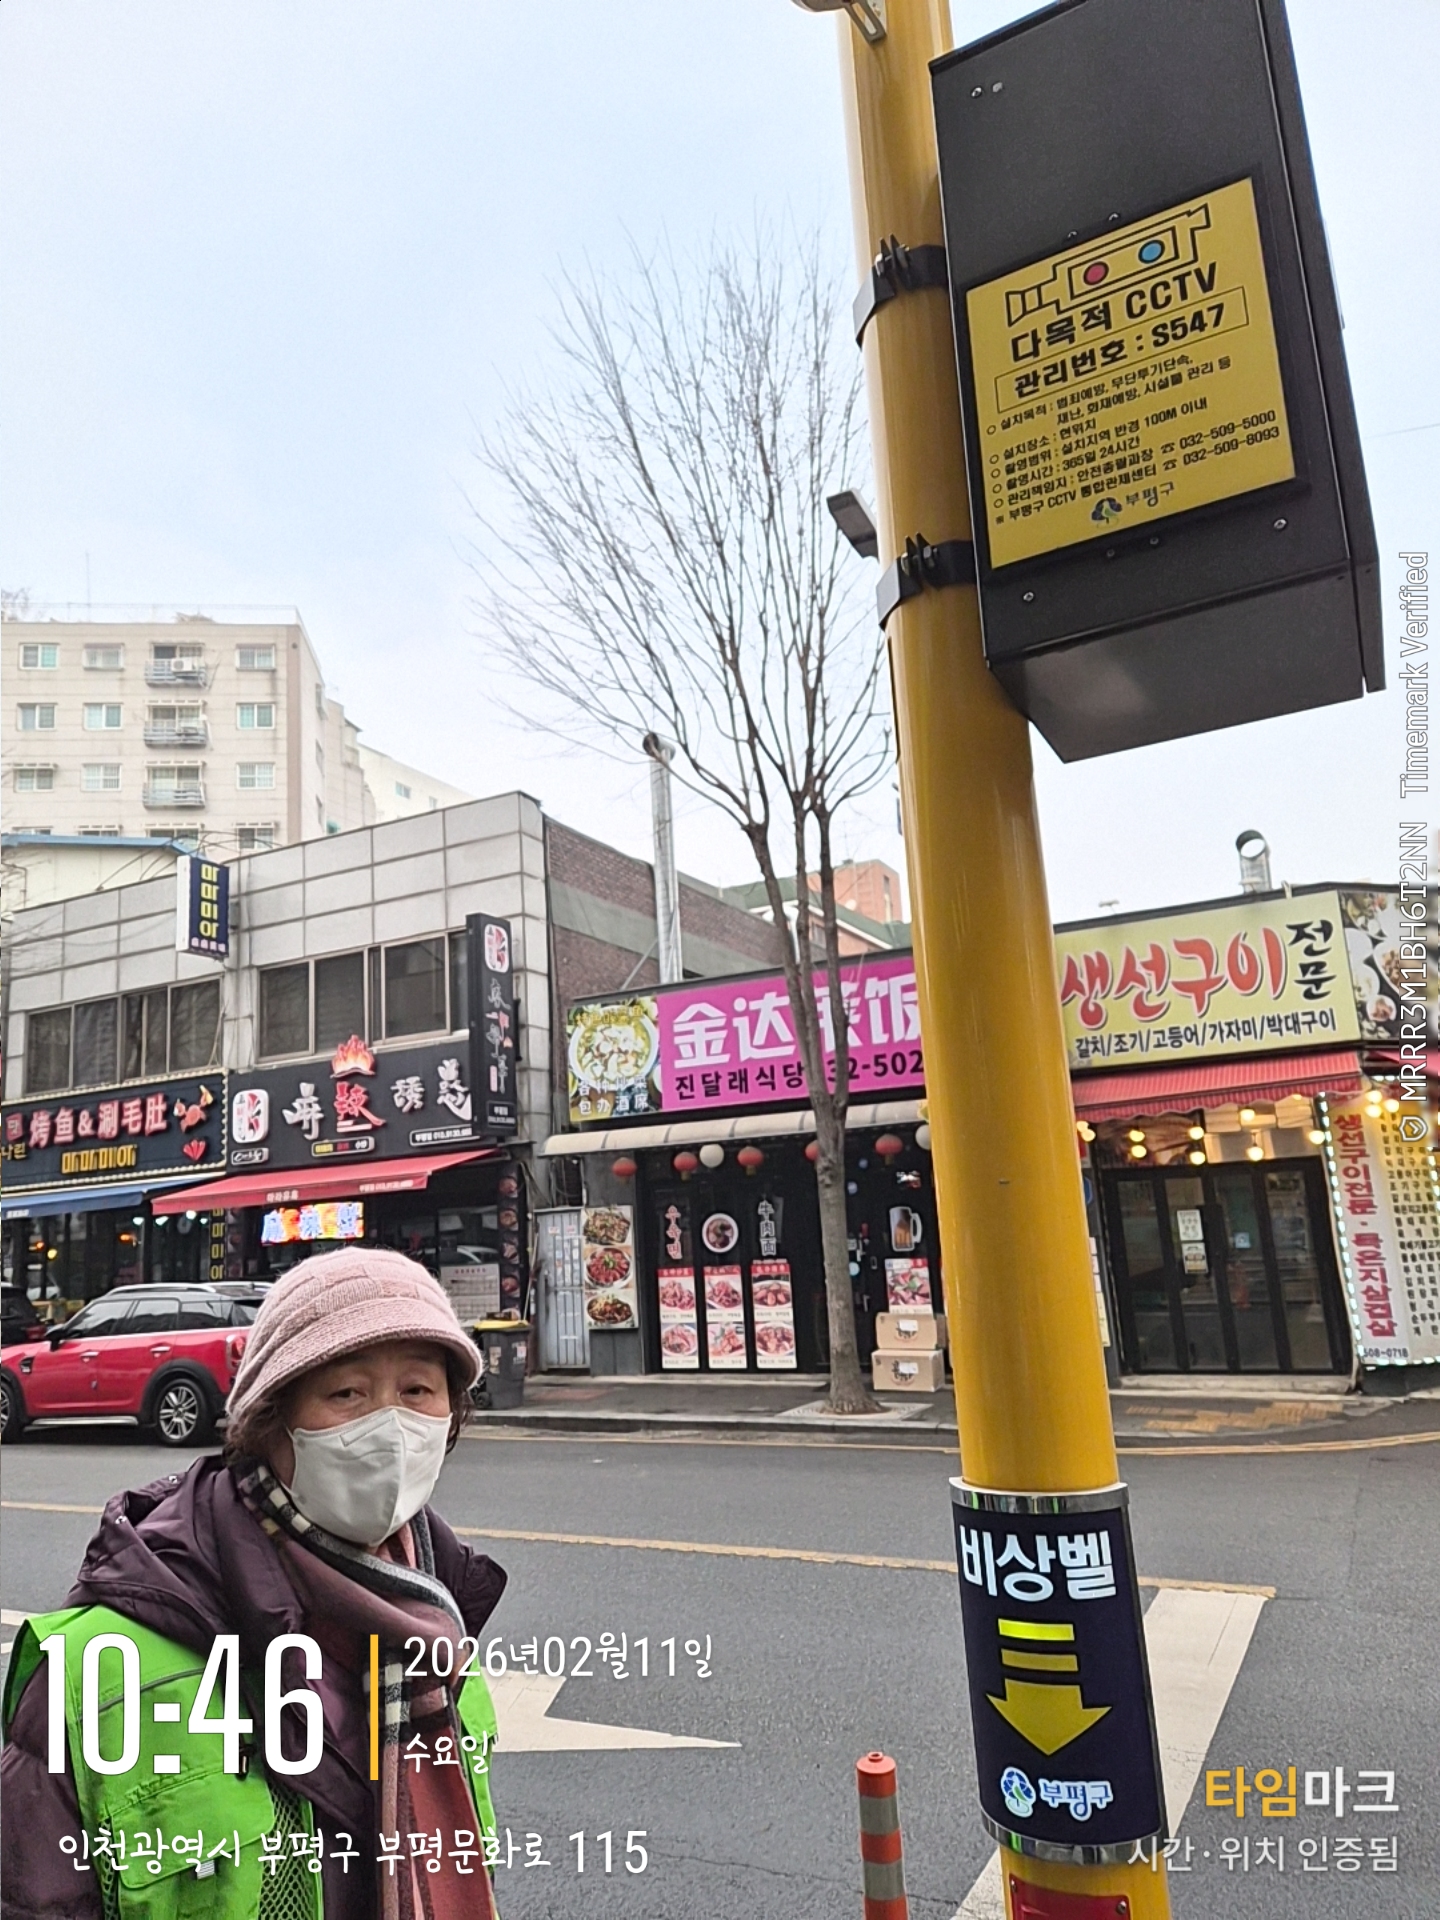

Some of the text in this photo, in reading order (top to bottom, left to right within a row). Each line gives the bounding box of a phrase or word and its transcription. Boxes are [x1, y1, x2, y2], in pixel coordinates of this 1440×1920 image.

[1011, 262, 1217, 362] 다목적 CCTV
[1014, 339, 1128, 398] 관리번호
[1151, 303, 1225, 348] S547
[1144, 372, 1183, 394] 시설물
[1187, 361, 1214, 380] 관리
[1218, 356, 1231, 370] 등
[1000, 404, 1047, 430] 설치목적
[1003, 435, 1051, 460] 설치장소
[1060, 418, 1096, 440] 현위치
[1005, 449, 1052, 475] 촬영범위
[1061, 429, 1111, 455] 설치지역
[1114, 419, 1140, 437] 반경
[1144, 407, 1177, 427] 100M
[1180, 397, 1207, 415] 이내
[1006, 465, 1053, 490] 촬영시간
[1062, 450, 1096, 471] 365일
[1100, 436, 1140, 458] 24시간
[1007, 475, 1067, 506] 관리책임자
[1179, 409, 1276, 450] 032-509-5000
[1009, 426, 1280, 520] 부평구 CCTV 통합관제센터 032-509-8093
[1125, 480, 1175, 507] 부평구
[1061, 919, 1337, 1029] 생선구이 전문
[1075, 1007, 1337, 1058] 갈치/조기/고등어/가자미/박대구이
[675, 1060, 805, 1101] 진달래식당
[959, 1525, 1117, 1602] 비상벨
[1040, 1778, 1113, 1821] 부평구
